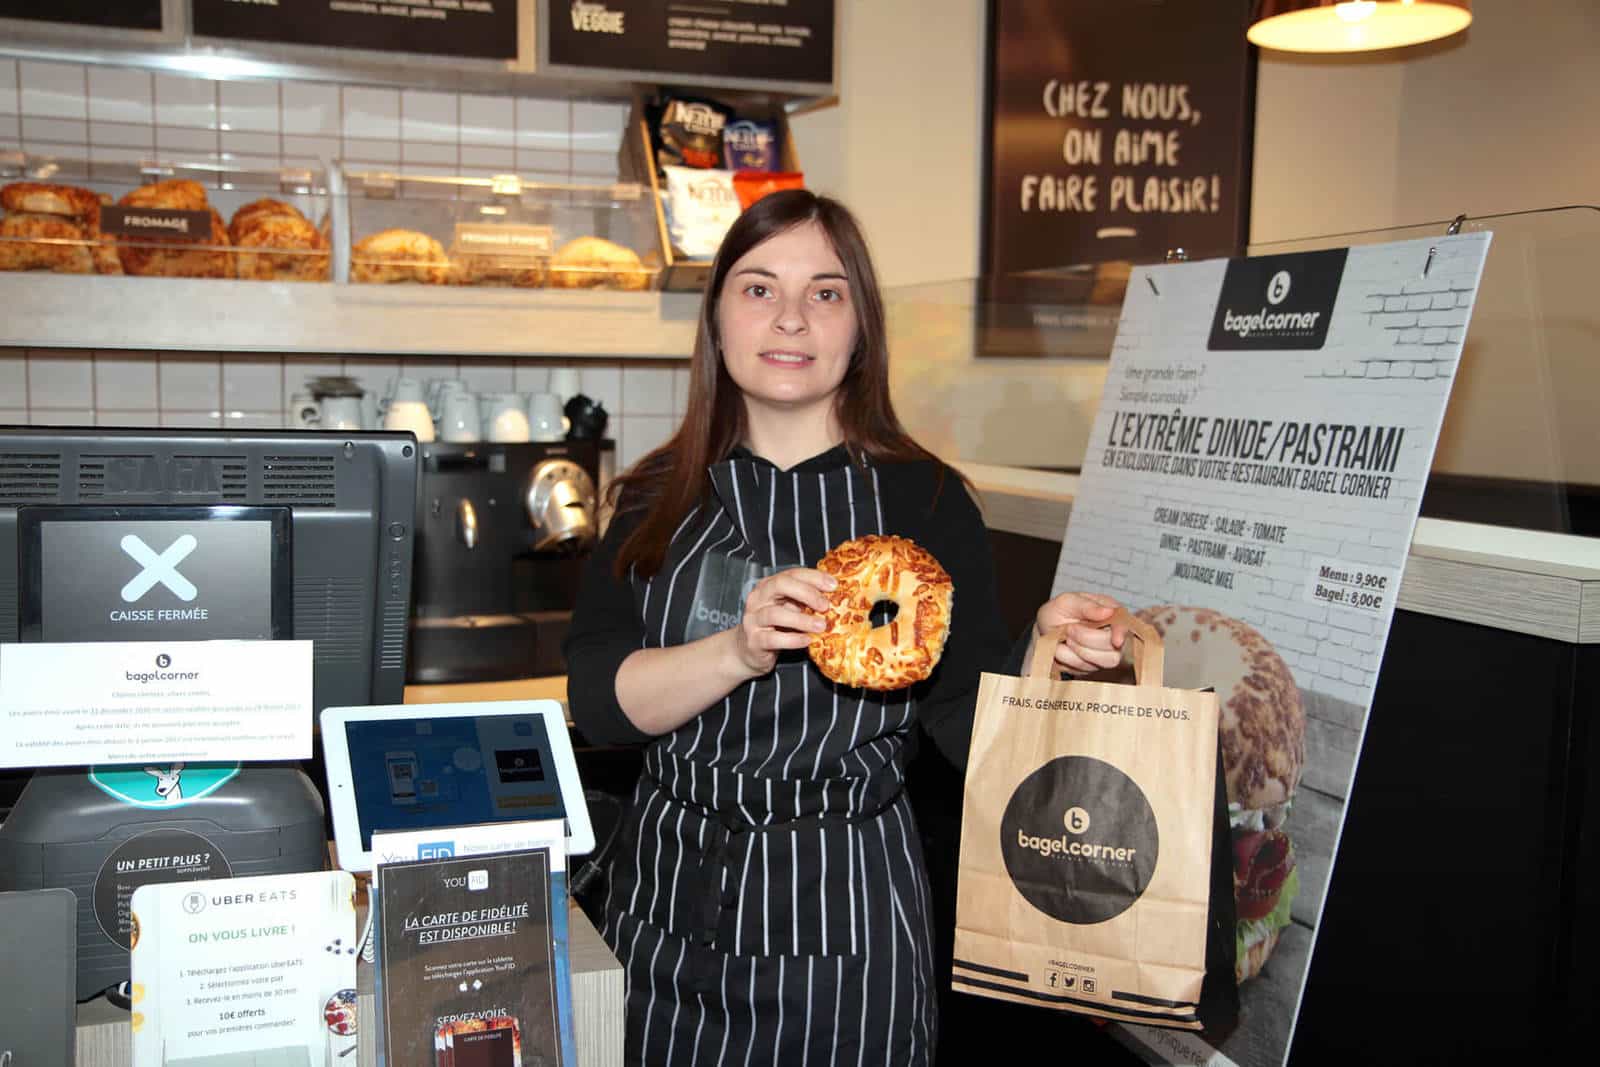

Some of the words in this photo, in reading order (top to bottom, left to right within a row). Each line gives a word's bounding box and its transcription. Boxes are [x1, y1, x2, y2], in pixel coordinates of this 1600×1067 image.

[572, 11, 625, 35] VEGGIE
[1043, 79, 1111, 118] CHEZ
[1122, 83, 1201, 126] NOUS,
[1063, 129, 1101, 166] ON
[124, 215, 188, 232] FROMAGE
[1224, 307, 1320, 338] bagelcorner
[1108, 408, 1208, 455] L'EXTRÊME
[1206, 417, 1405, 472] DINDE/PASTRAMI
[1102, 449, 1115, 469] EN
[1171, 456, 1198, 478] DANS
[1198, 459, 1231, 482] VOTRE
[1230, 463, 1302, 490] RESTAURANT
[1300, 471, 1338, 494] BAGEL
[1339, 475, 1392, 500] CORNER
[1153, 507, 1180, 526] CREAM
[1179, 511, 1209, 531] CHEESE
[1214, 516, 1246, 537] SALADE
[1252, 522, 1288, 544] TOMATE
[1160, 533, 1183, 552] DINDE
[1187, 538, 1227, 560] PASTRAMI
[1232, 546, 1267, 568] AVOCAT
[1174, 562, 1216, 586] MOUTARDE
[1214, 570, 1235, 591] MIEL
[1319, 565, 1349, 582] Menu
[1355, 572, 1388, 589] 9,90€
[1315, 584, 1345, 602] Bagel
[1351, 592, 1383, 609] 8,00€
[110, 610, 155, 622] CAISSE
[158, 606, 209, 621] FERMÉE
[126, 670, 200, 684] bagelcorner
[1002, 695, 1034, 709] FRAIS.
[1086, 702, 1134, 717] PROCHE
[1136, 706, 1153, 718] DE
[1155, 708, 1191, 721] VOUS.
[1018, 829, 1137, 862] bagelcorner
[116, 860, 136, 872] UN
[138, 857, 170, 870] PETIT
[172, 854, 202, 867] PLUS
[443, 878, 467, 889] YOU
[212, 893, 255, 906] UBER
[259, 889, 298, 903] EATS
[405, 917, 420, 930] LA
[421, 911, 460, 927] CARTE
[461, 908, 480, 923] DE
[480, 901, 530, 921] FIDÉLITÉ
[189, 932, 208, 944] ON
[212, 927, 248, 943] VOUS
[251, 925, 289, 938] LIVRE
[420, 929, 440, 944] EST
[219, 1010, 236, 1021] 10€
[237, 1007, 266, 1019] offerts
[437, 1006, 508, 1026] SERVEZ-VOUS
